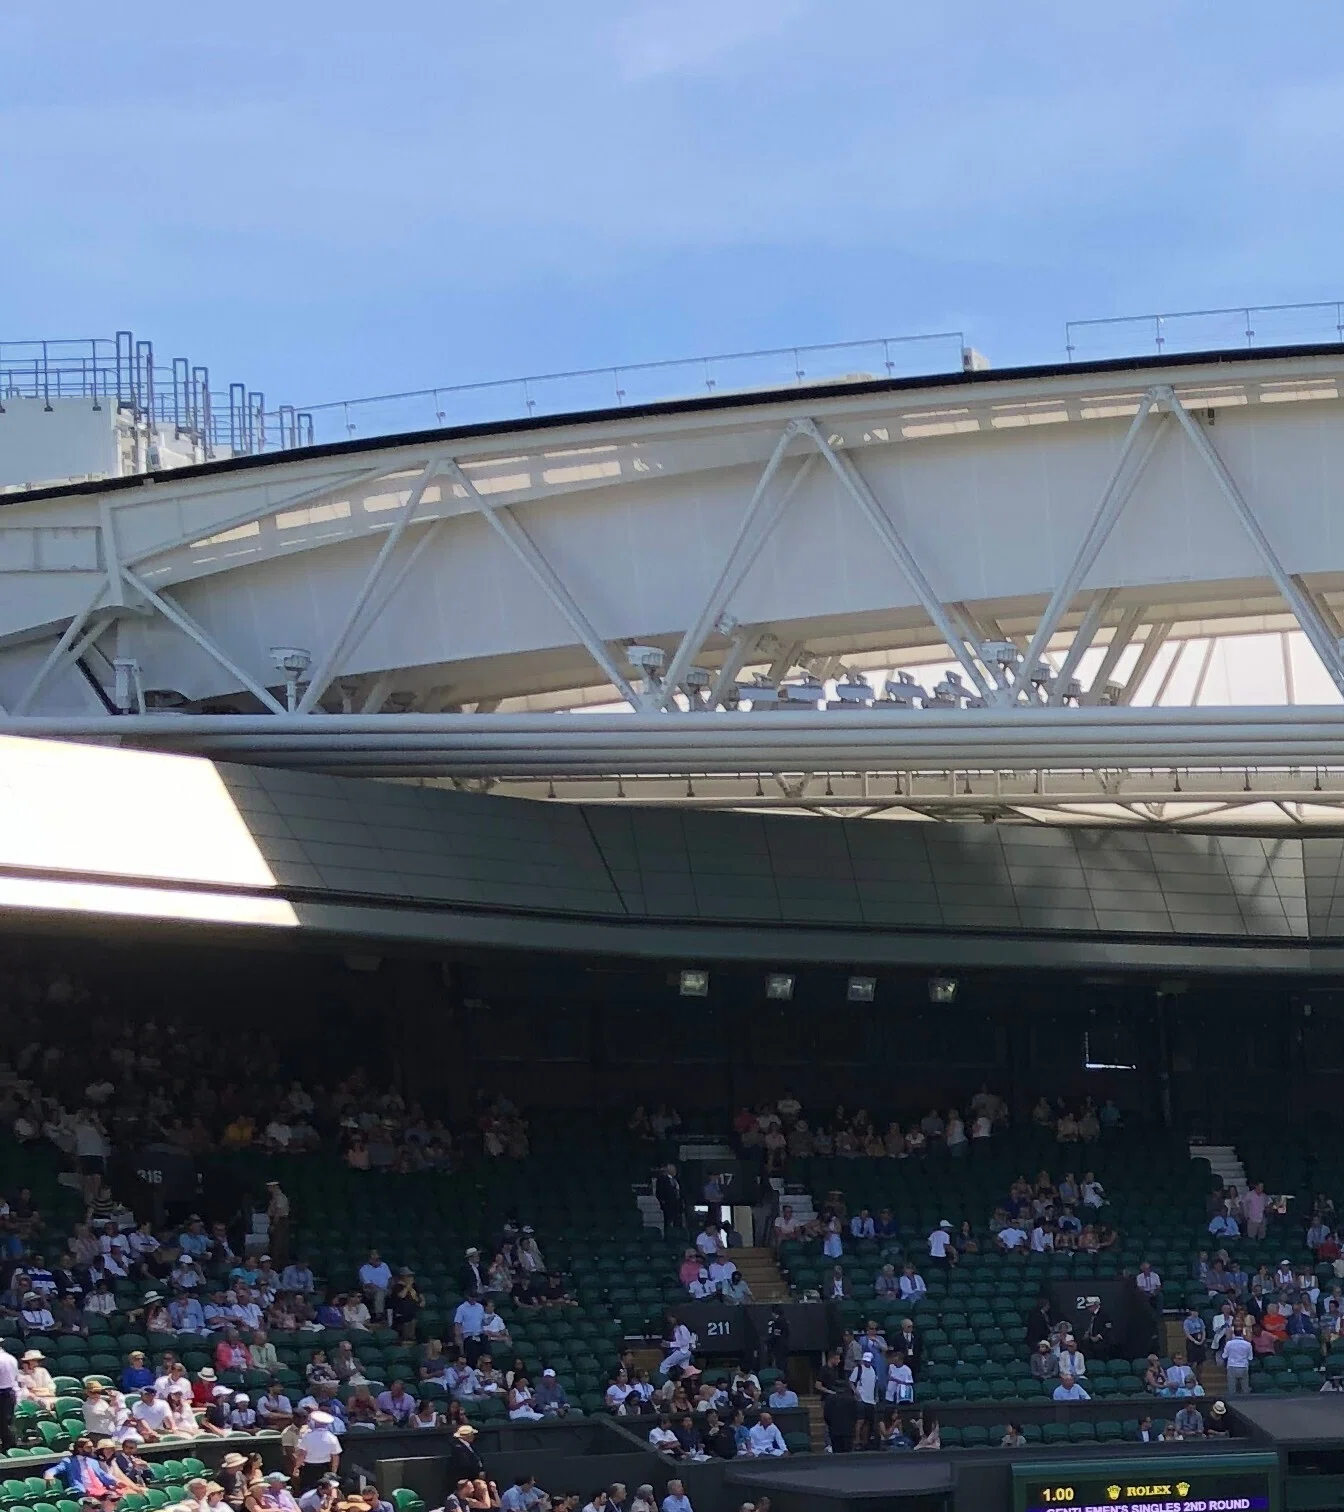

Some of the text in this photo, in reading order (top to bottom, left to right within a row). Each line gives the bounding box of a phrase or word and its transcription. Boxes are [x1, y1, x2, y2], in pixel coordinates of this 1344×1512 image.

[707, 1321, 730, 1336] 211
[1042, 1487, 1075, 1501] 1.00
[1126, 1484, 1172, 1497] ROLEX
[1183, 1500, 1207, 1512] 2ND
[1208, 1498, 1250, 1511] ROUND
